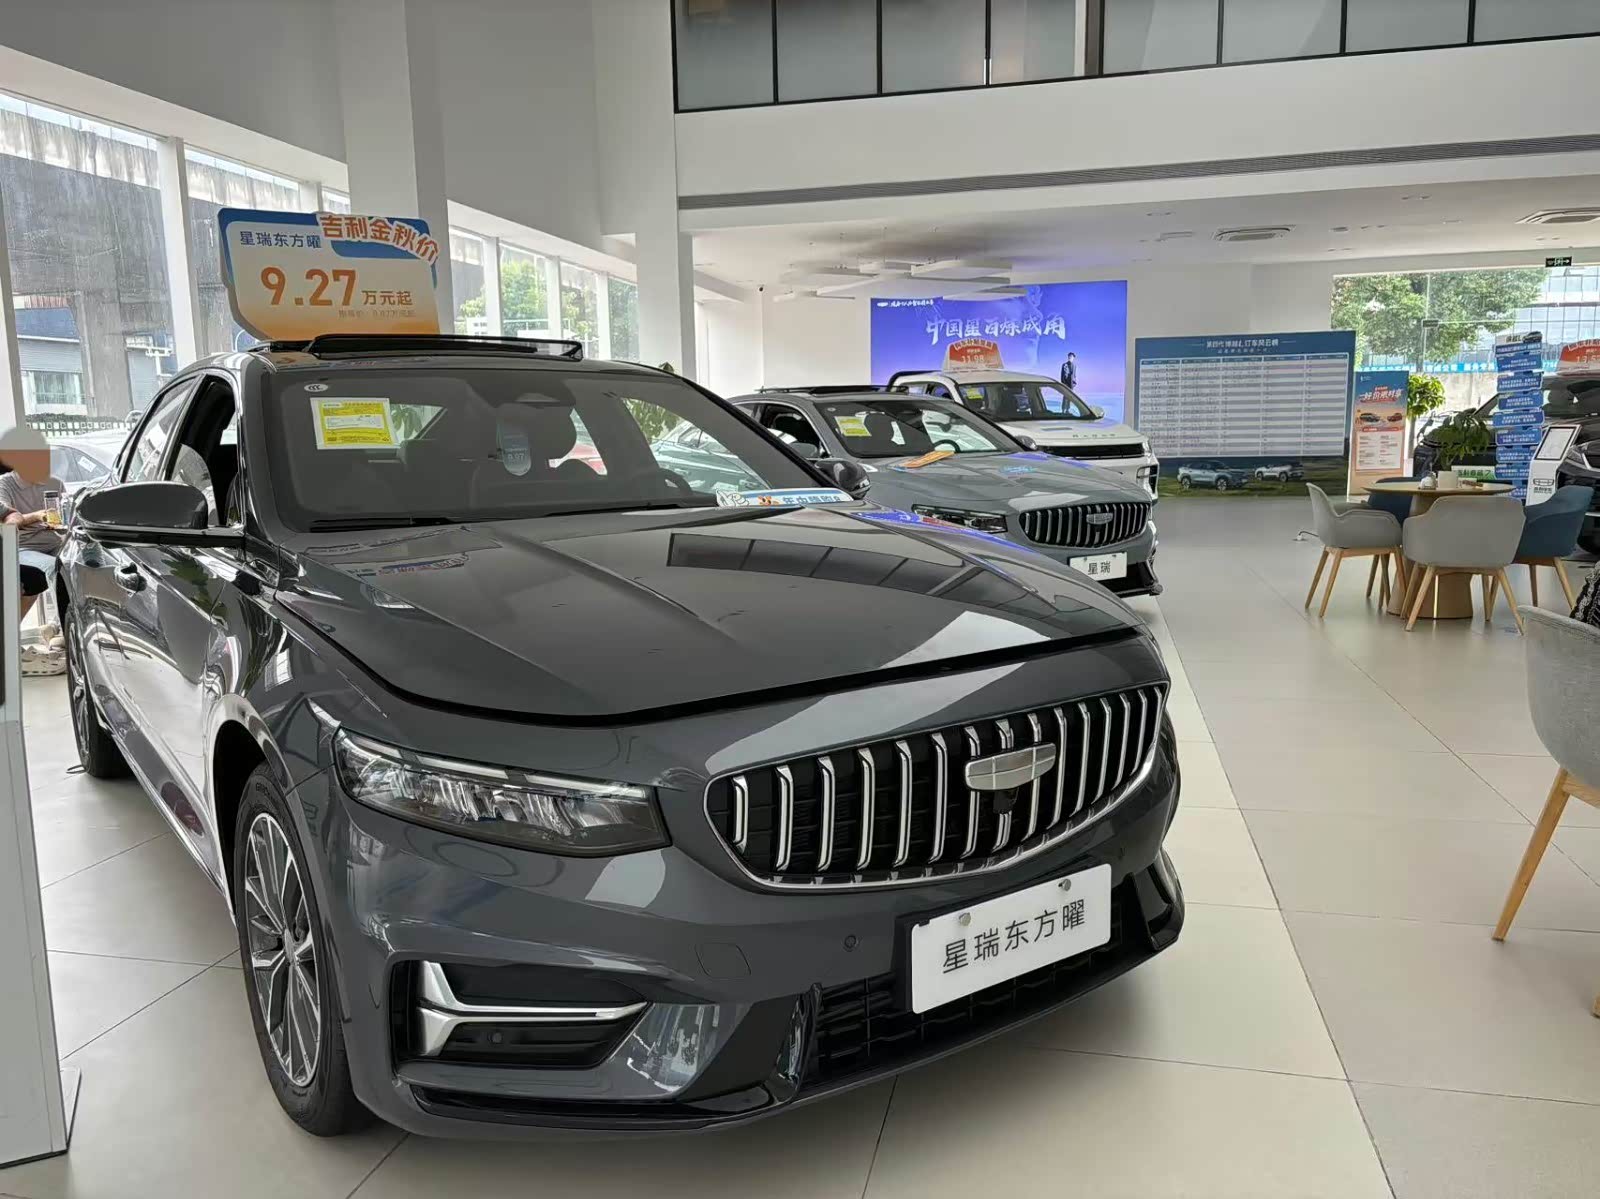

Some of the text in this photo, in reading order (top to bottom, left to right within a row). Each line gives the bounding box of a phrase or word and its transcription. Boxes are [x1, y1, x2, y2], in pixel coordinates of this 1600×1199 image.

[240, 231, 322, 249] 星瑞东方曜
[319, 214, 439, 262] 吉利金秋价
[260, 266, 356, 307] 9.27
[361, 290, 413, 307] 万元起
[1088, 560, 1111, 575] 星瑞
[942, 899, 1085, 975] 星瑞东方曜
